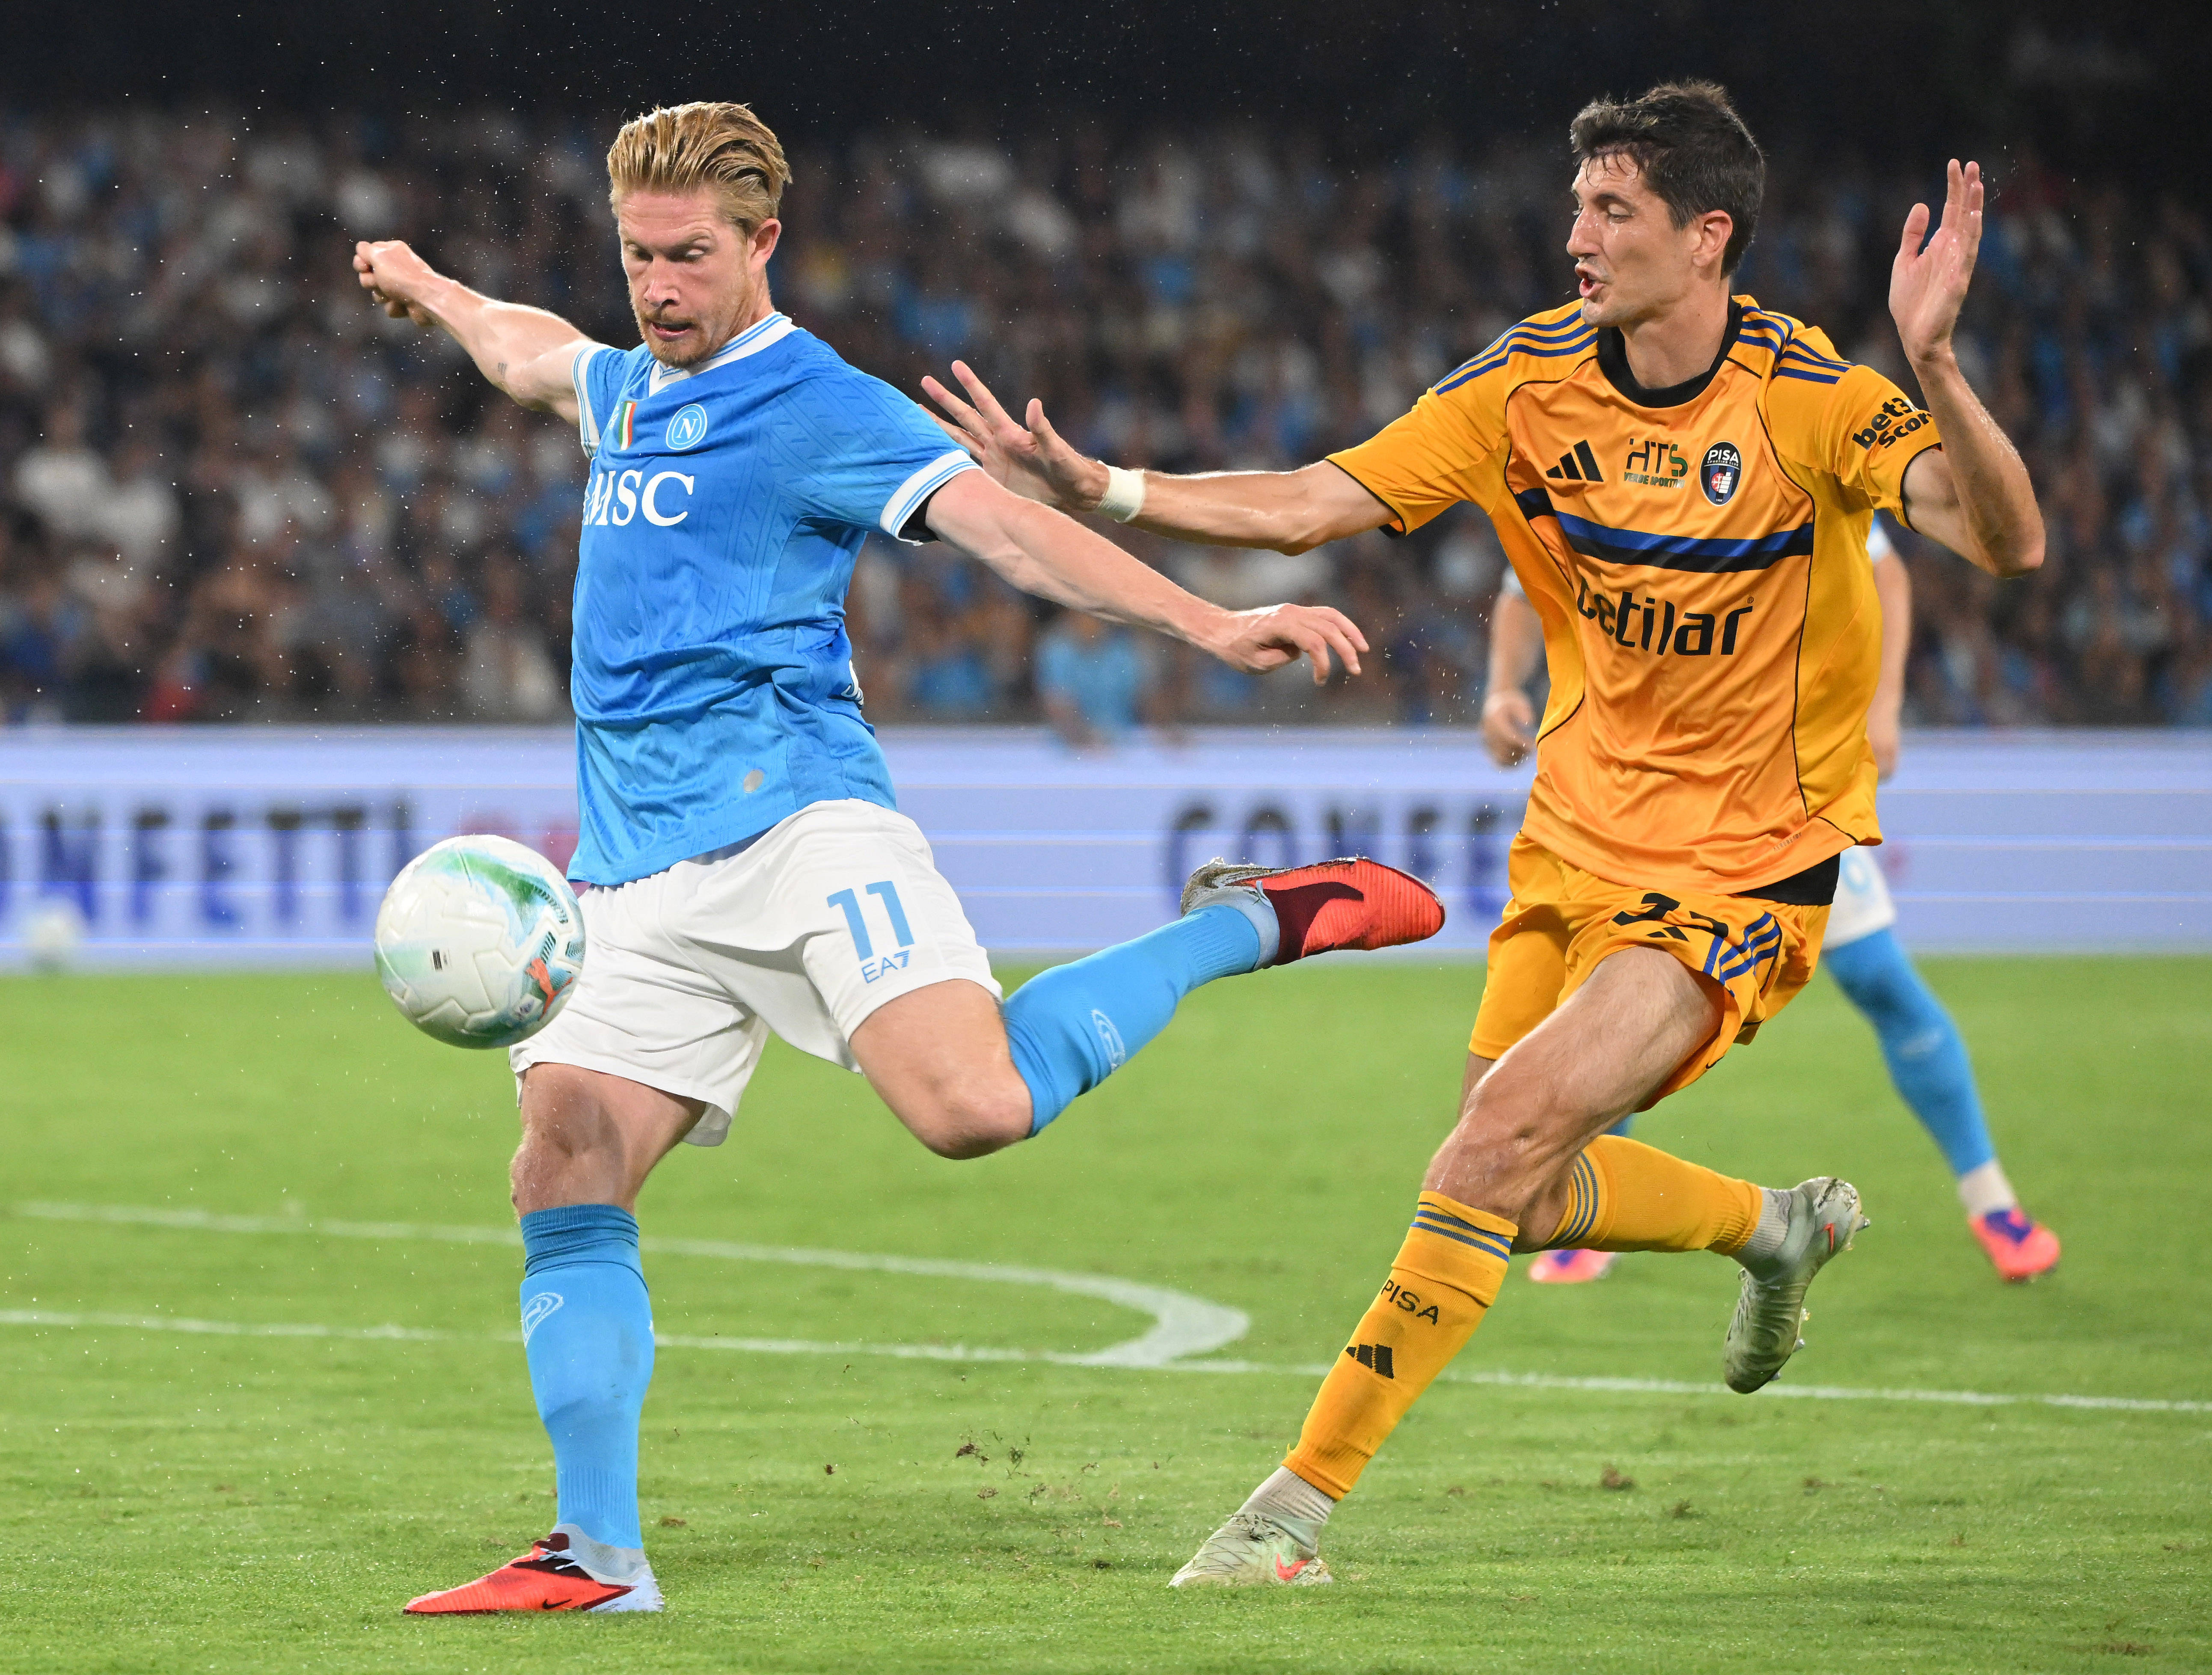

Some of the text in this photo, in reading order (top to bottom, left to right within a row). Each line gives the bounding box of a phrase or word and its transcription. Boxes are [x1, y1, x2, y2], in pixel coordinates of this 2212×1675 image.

[1708, 449, 1739, 463] PISA
[826, 880, 915, 962] 11
[861, 950, 910, 984] EA7
[1381, 1279, 1439, 1326] PISA
